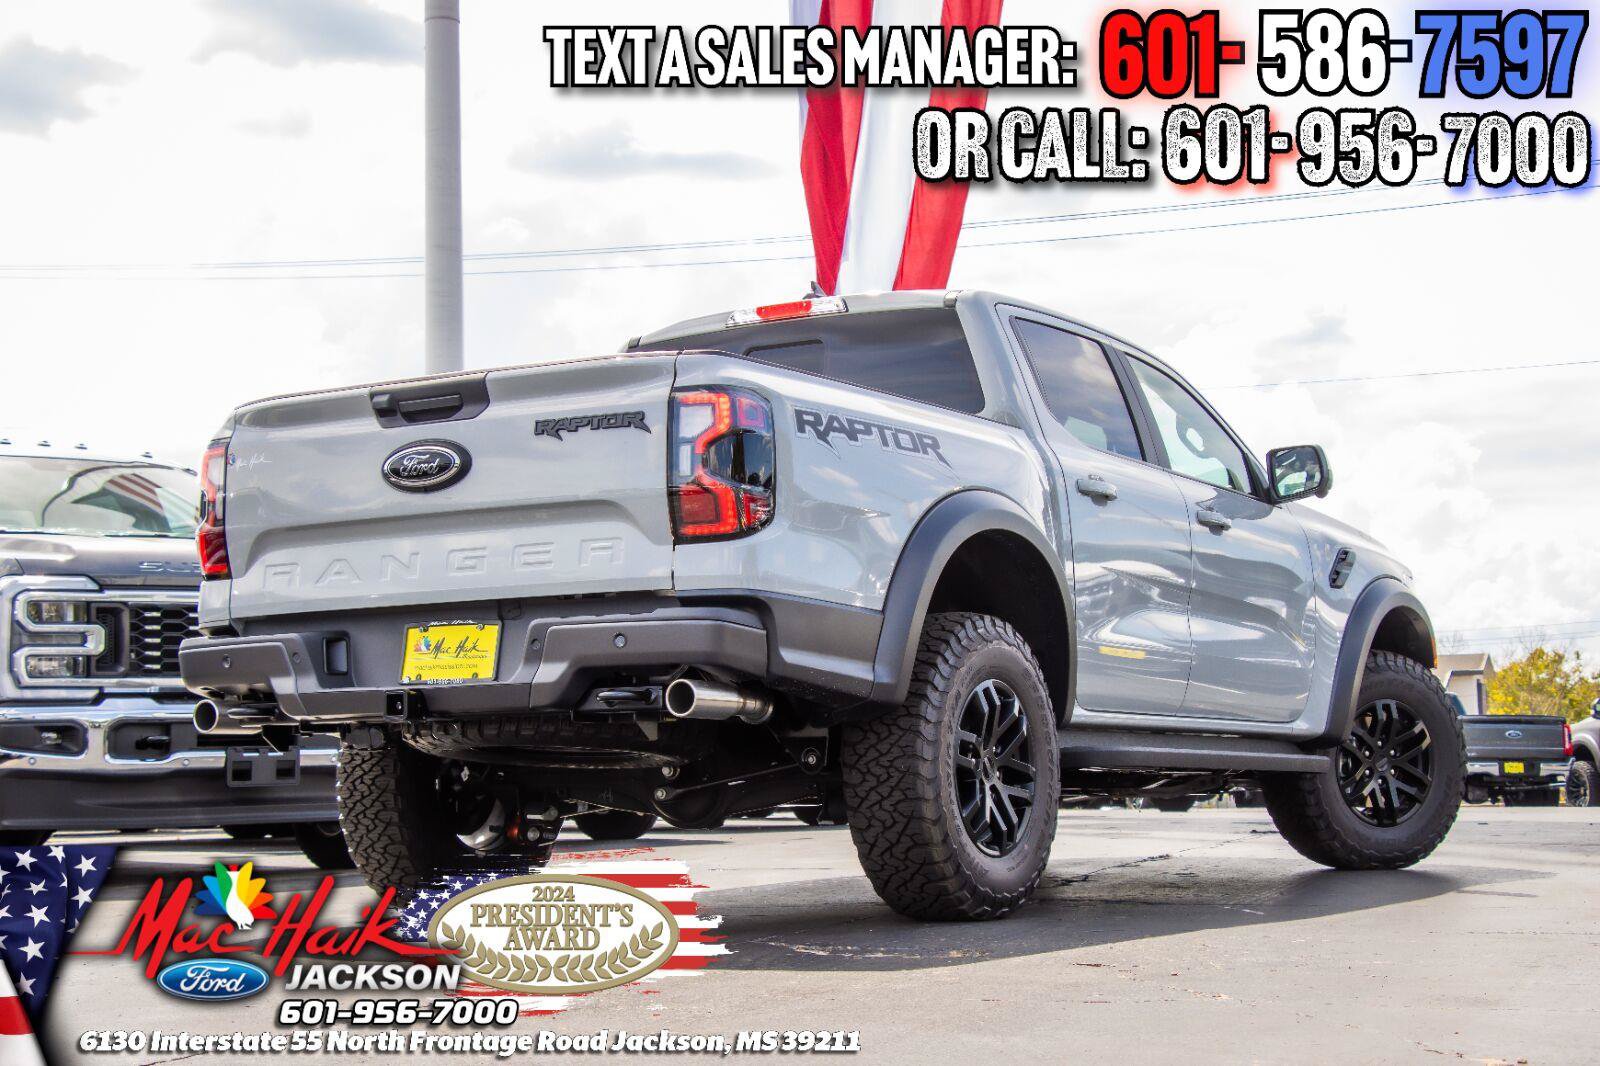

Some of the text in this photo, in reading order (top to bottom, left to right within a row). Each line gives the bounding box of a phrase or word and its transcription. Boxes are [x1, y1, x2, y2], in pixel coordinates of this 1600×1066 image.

[534, 410, 651, 441] RAPTOR
[793, 405, 955, 473] RAPTOR
[400, 454, 441, 477] Ford
[260, 537, 627, 593] RANGER
